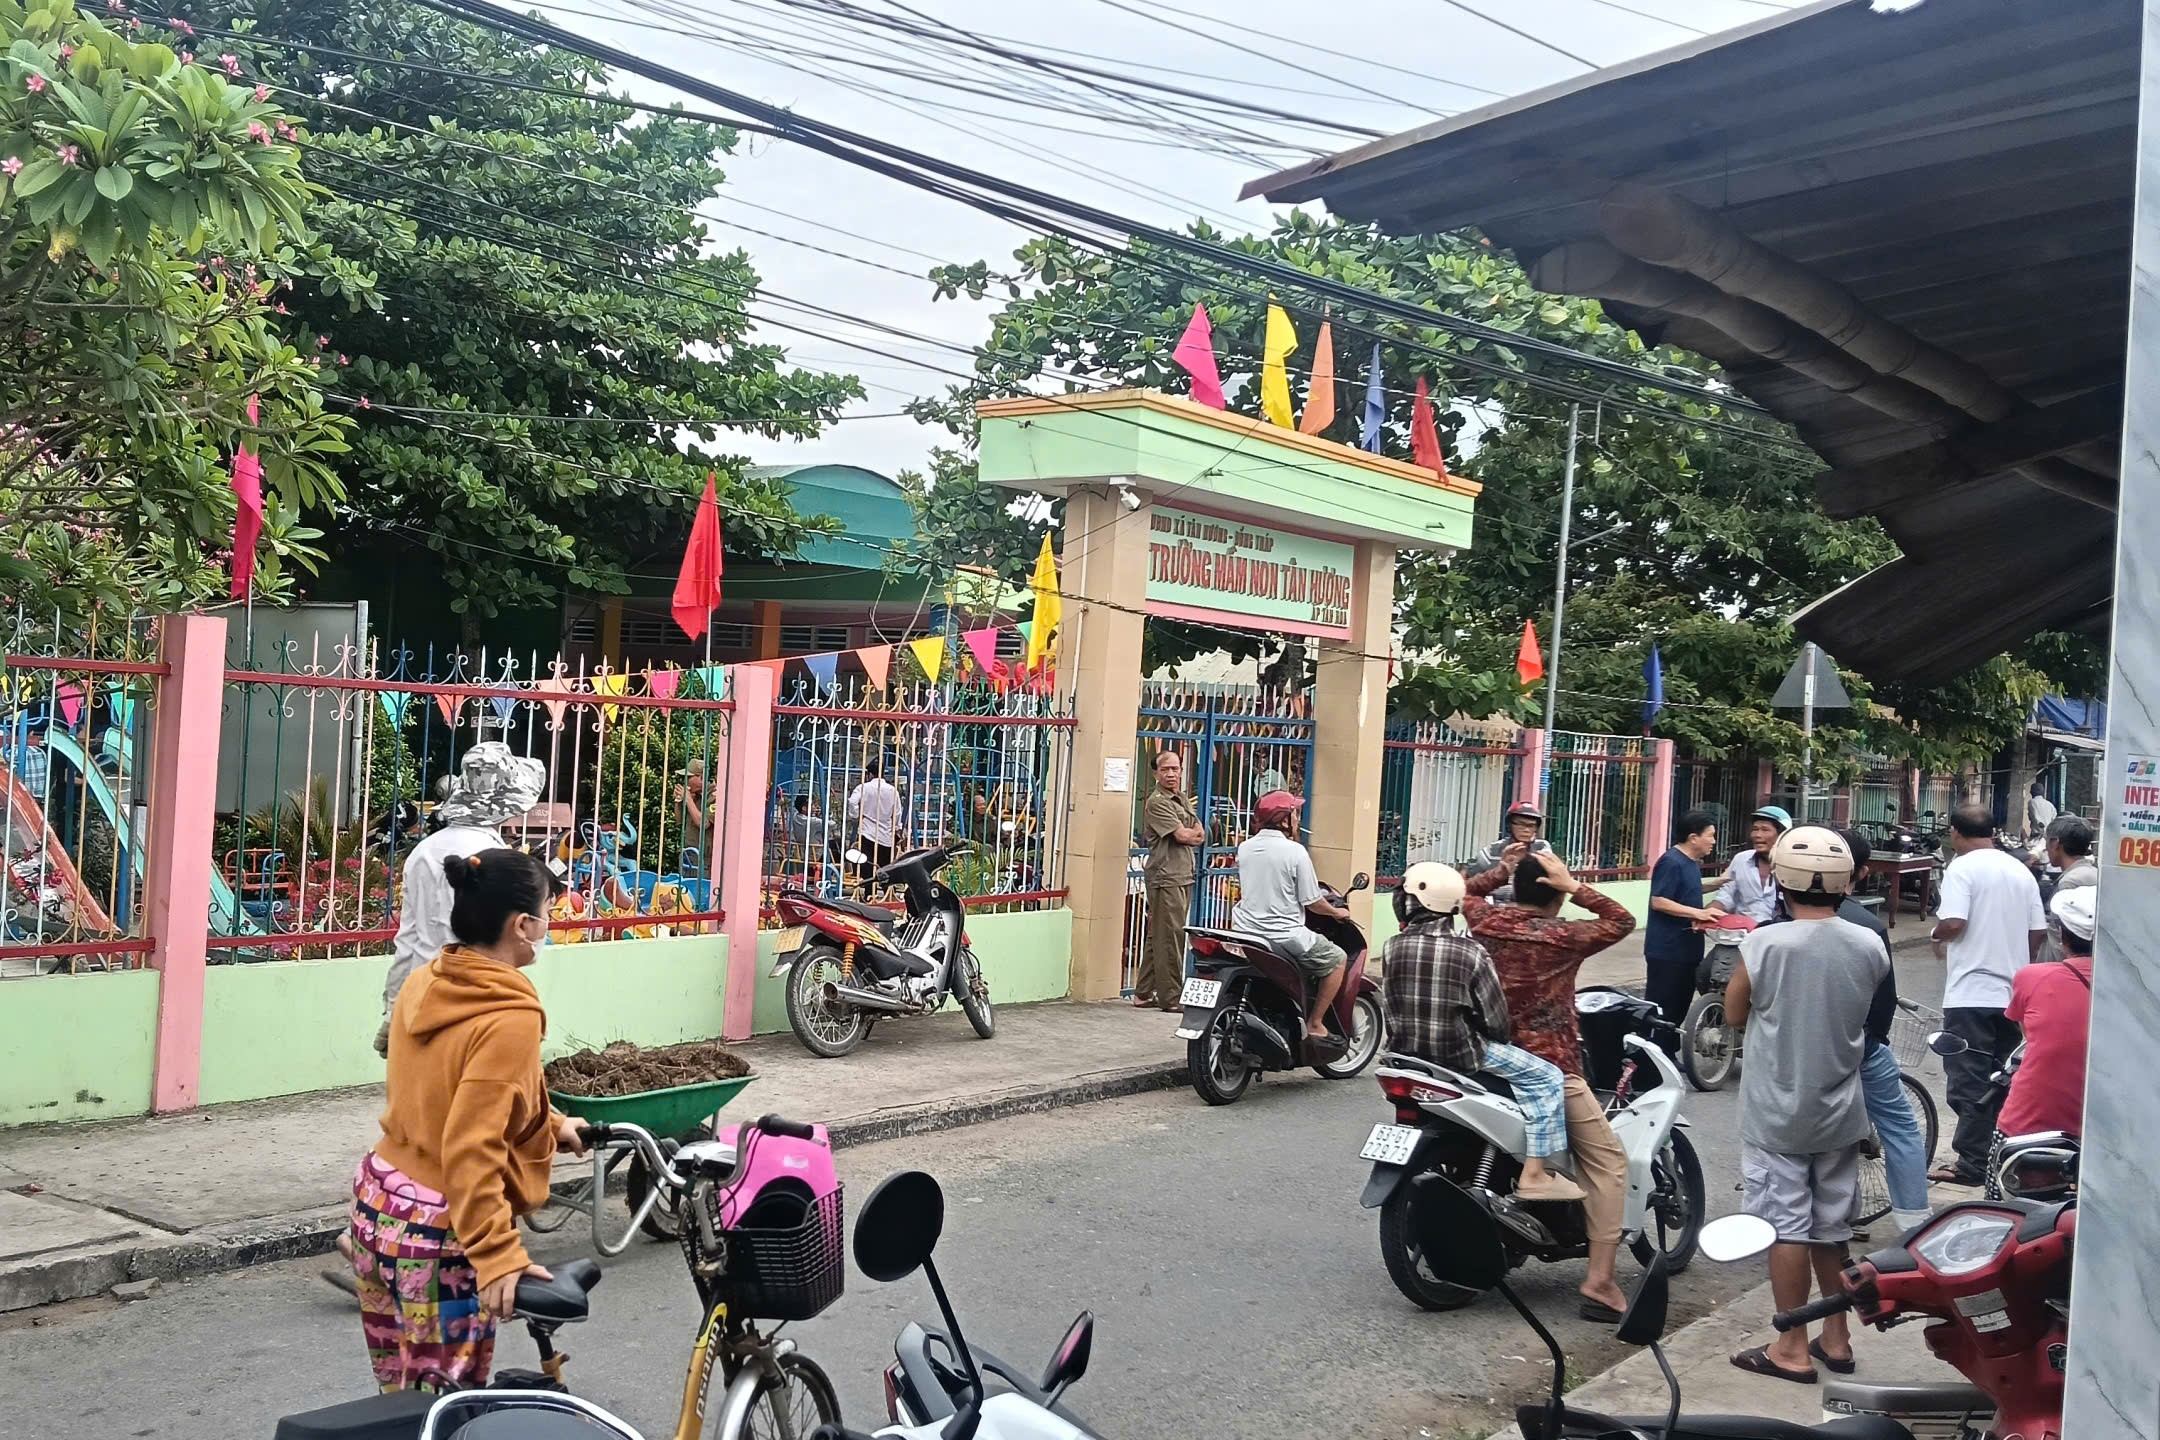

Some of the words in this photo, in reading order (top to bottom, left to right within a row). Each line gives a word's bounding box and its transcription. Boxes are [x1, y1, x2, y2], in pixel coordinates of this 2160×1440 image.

[1149, 538, 1212, 589] TRƯỜNG
[1247, 559, 1279, 600] NON
[1280, 557, 1307, 603] TÂN
[1307, 565, 1350, 610] HƯƠNG
[2124, 785, 2160, 807] INTE
